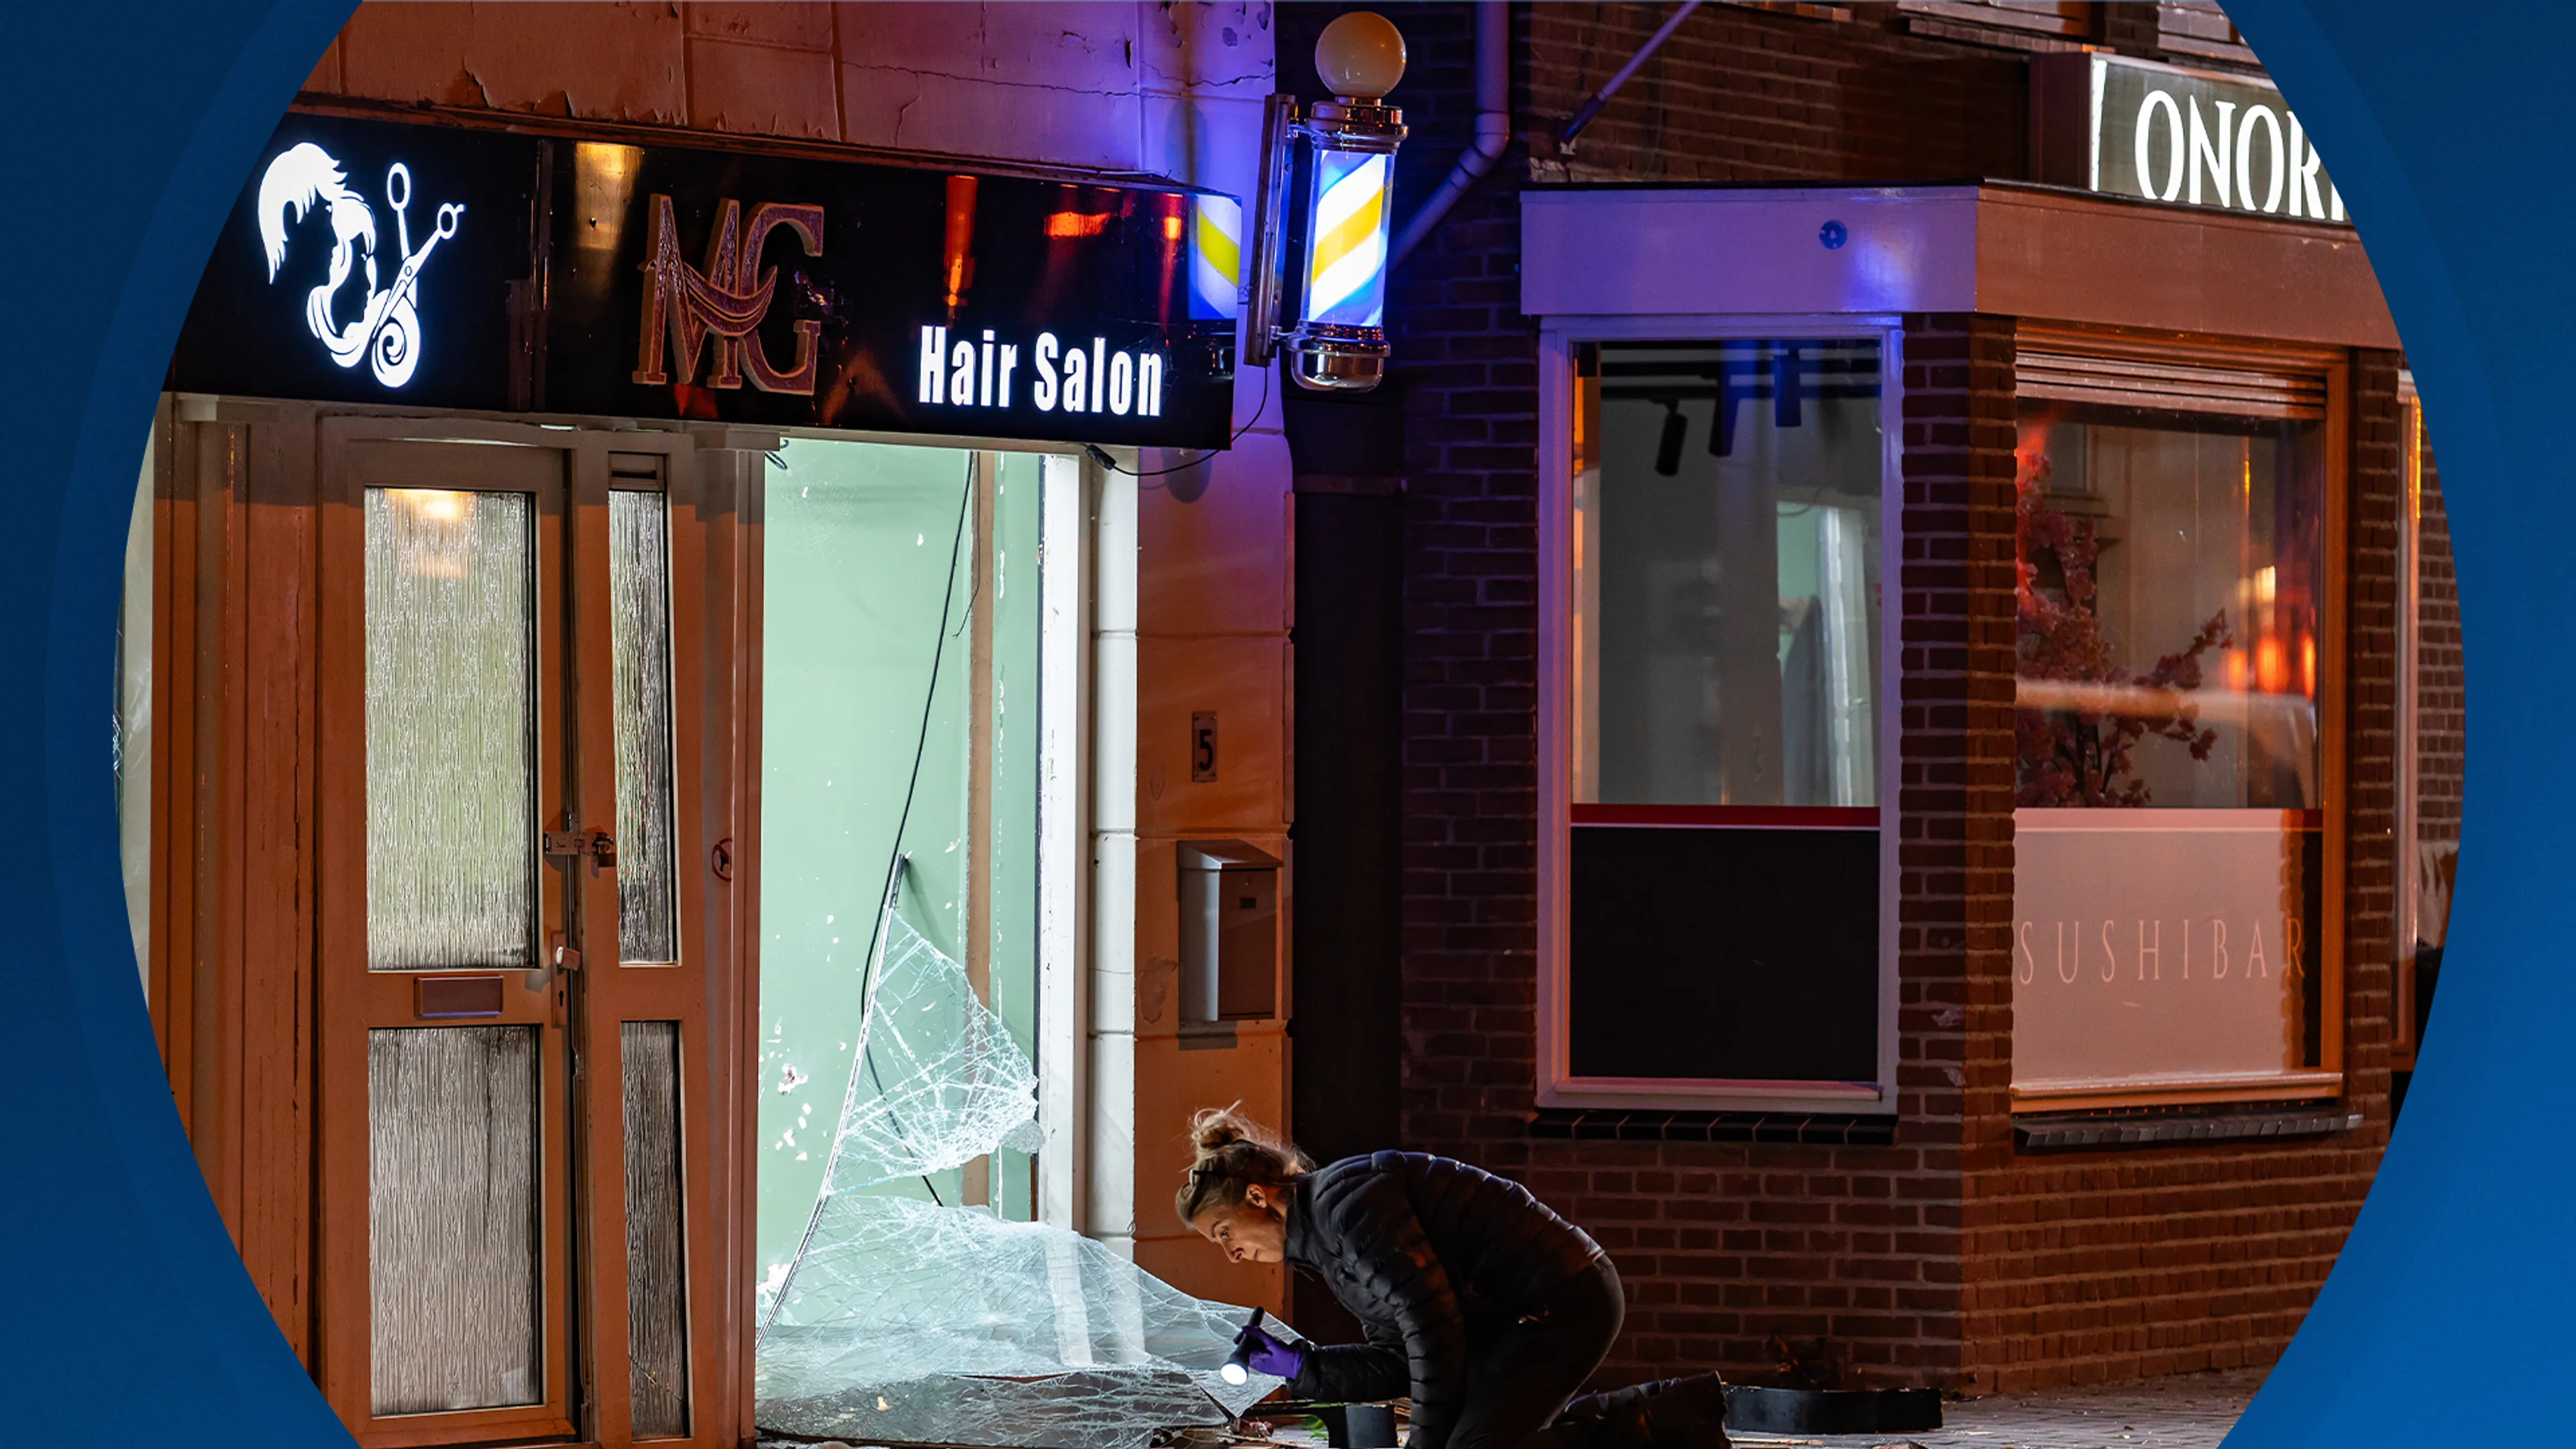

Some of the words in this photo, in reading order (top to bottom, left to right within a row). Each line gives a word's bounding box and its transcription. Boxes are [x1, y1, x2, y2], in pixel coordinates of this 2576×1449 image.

[631, 193, 824, 396] MG
[918, 325, 1017, 408] Hair
[1033, 331, 1163, 417] Salon
[1199, 729, 1214, 771] 5
